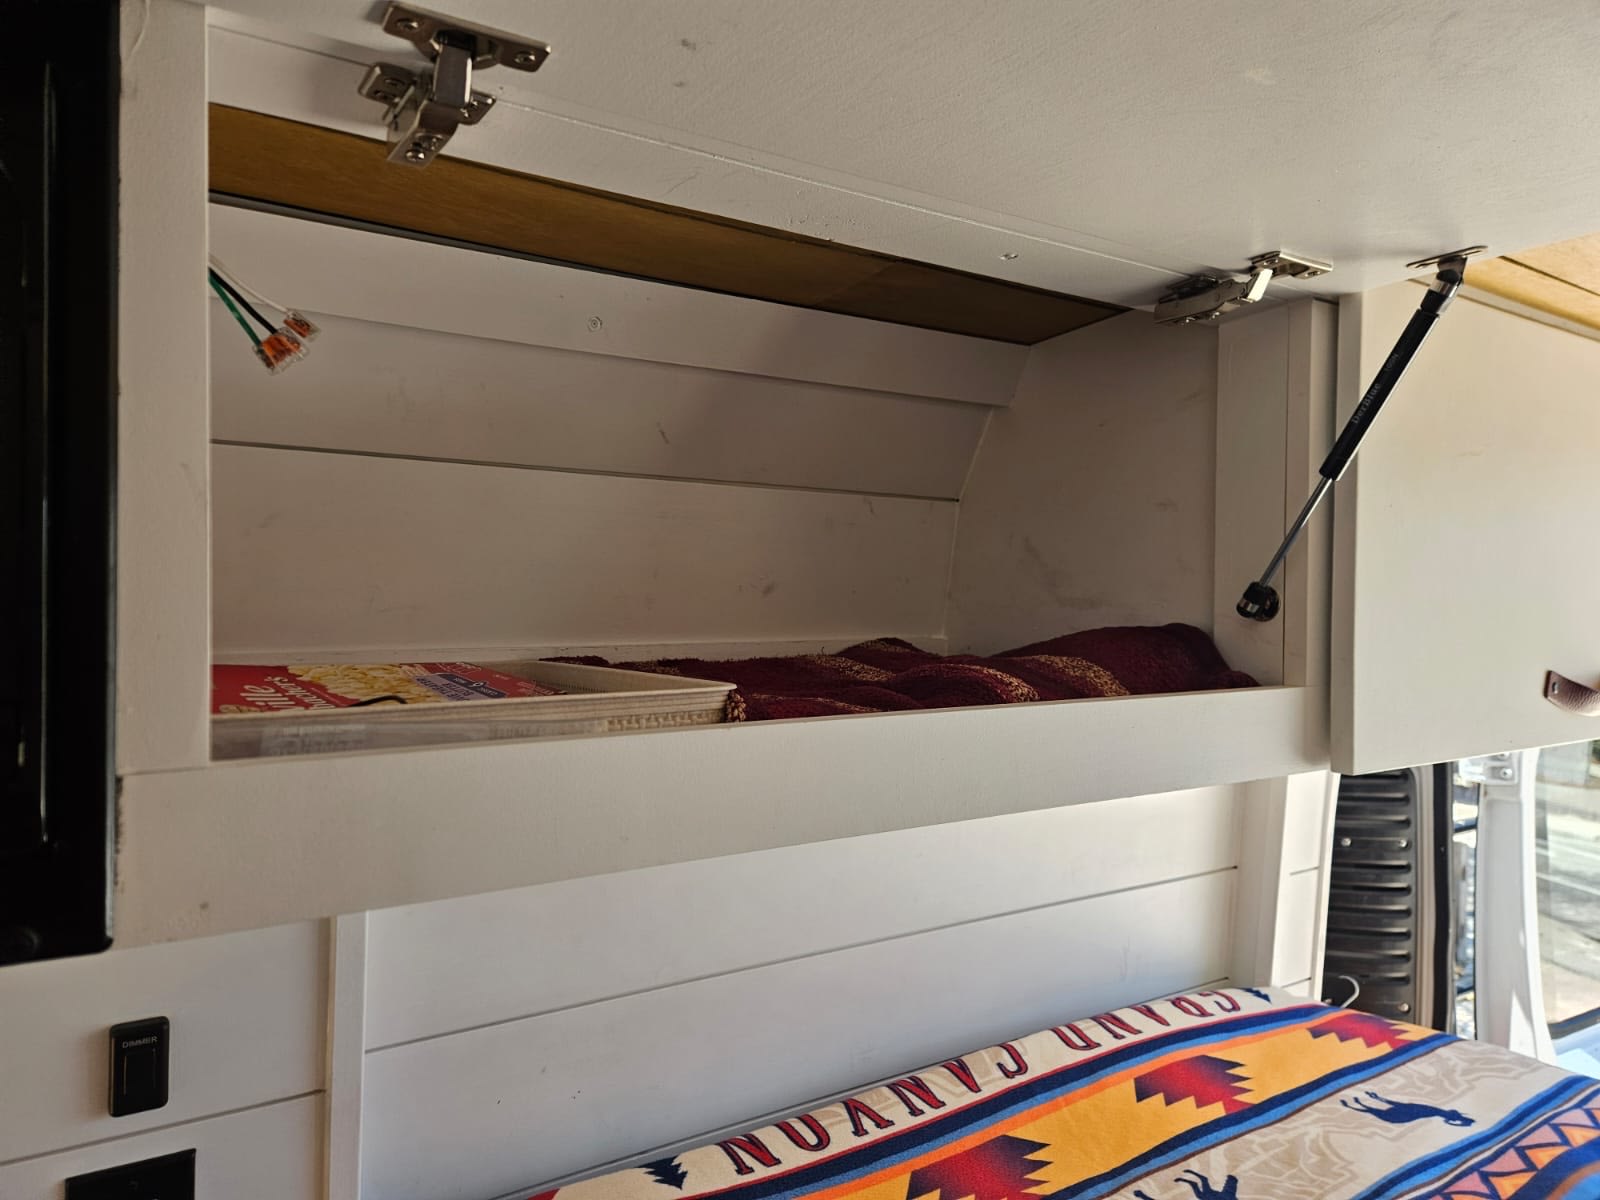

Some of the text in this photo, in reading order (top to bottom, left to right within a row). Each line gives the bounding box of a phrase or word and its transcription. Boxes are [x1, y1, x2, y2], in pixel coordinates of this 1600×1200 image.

[1351, 383, 1382, 424] DerBlue
[122, 1035, 158, 1049] DIMMER
[717, 990, 1241, 1176] GRAND CANYON
